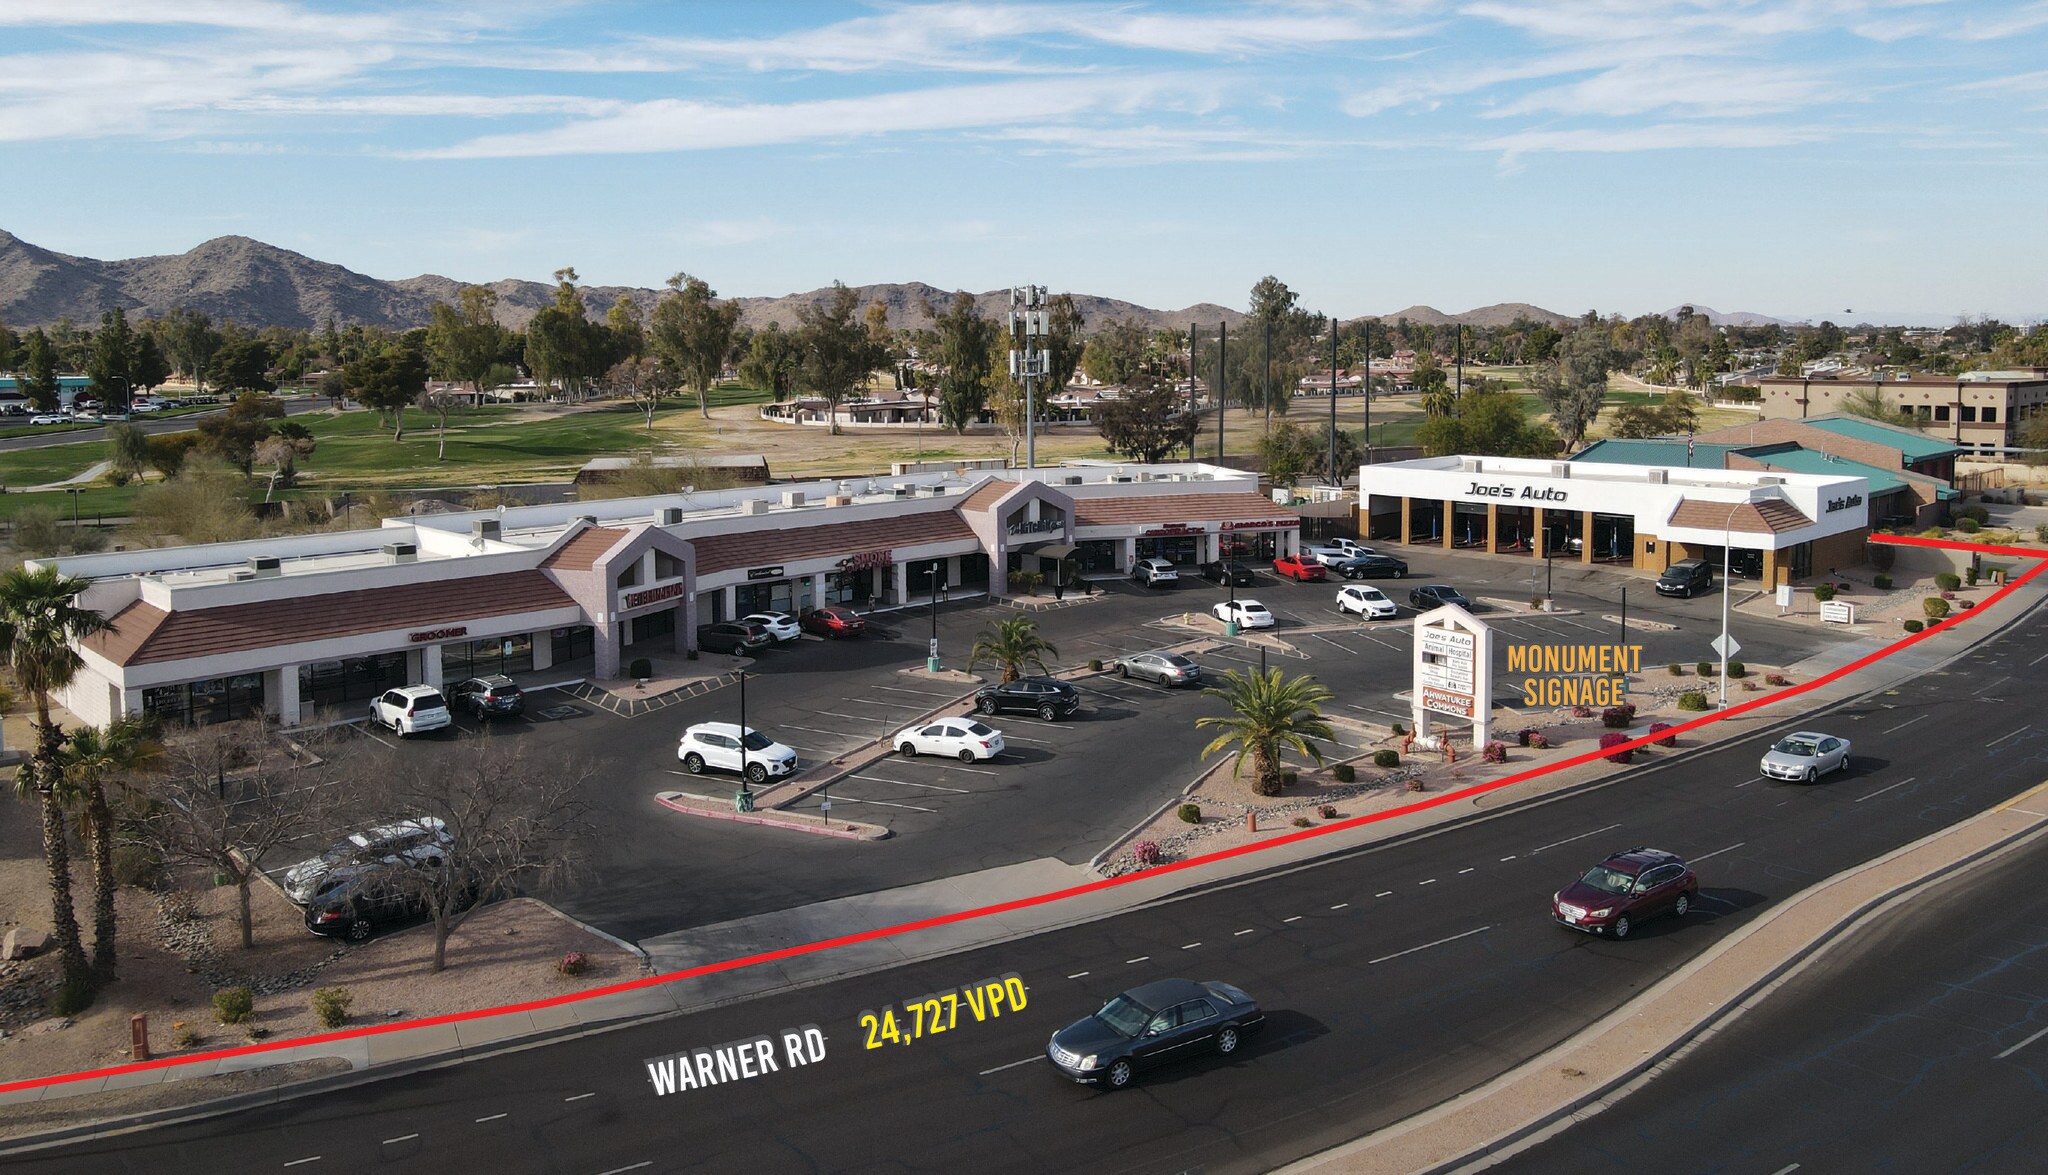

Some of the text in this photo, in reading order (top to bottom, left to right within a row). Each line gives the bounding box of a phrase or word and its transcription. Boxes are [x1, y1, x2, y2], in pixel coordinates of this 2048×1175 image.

[1465, 482, 1568, 502] Joe's Auto
[853, 550, 893, 566] SMOKE
[409, 626, 468, 643] GROOMER
[1450, 636, 1471, 646] Auto
[1424, 642, 1472, 658] Animal Hospital
[1423, 690, 1472, 707] AHWATUKEE
